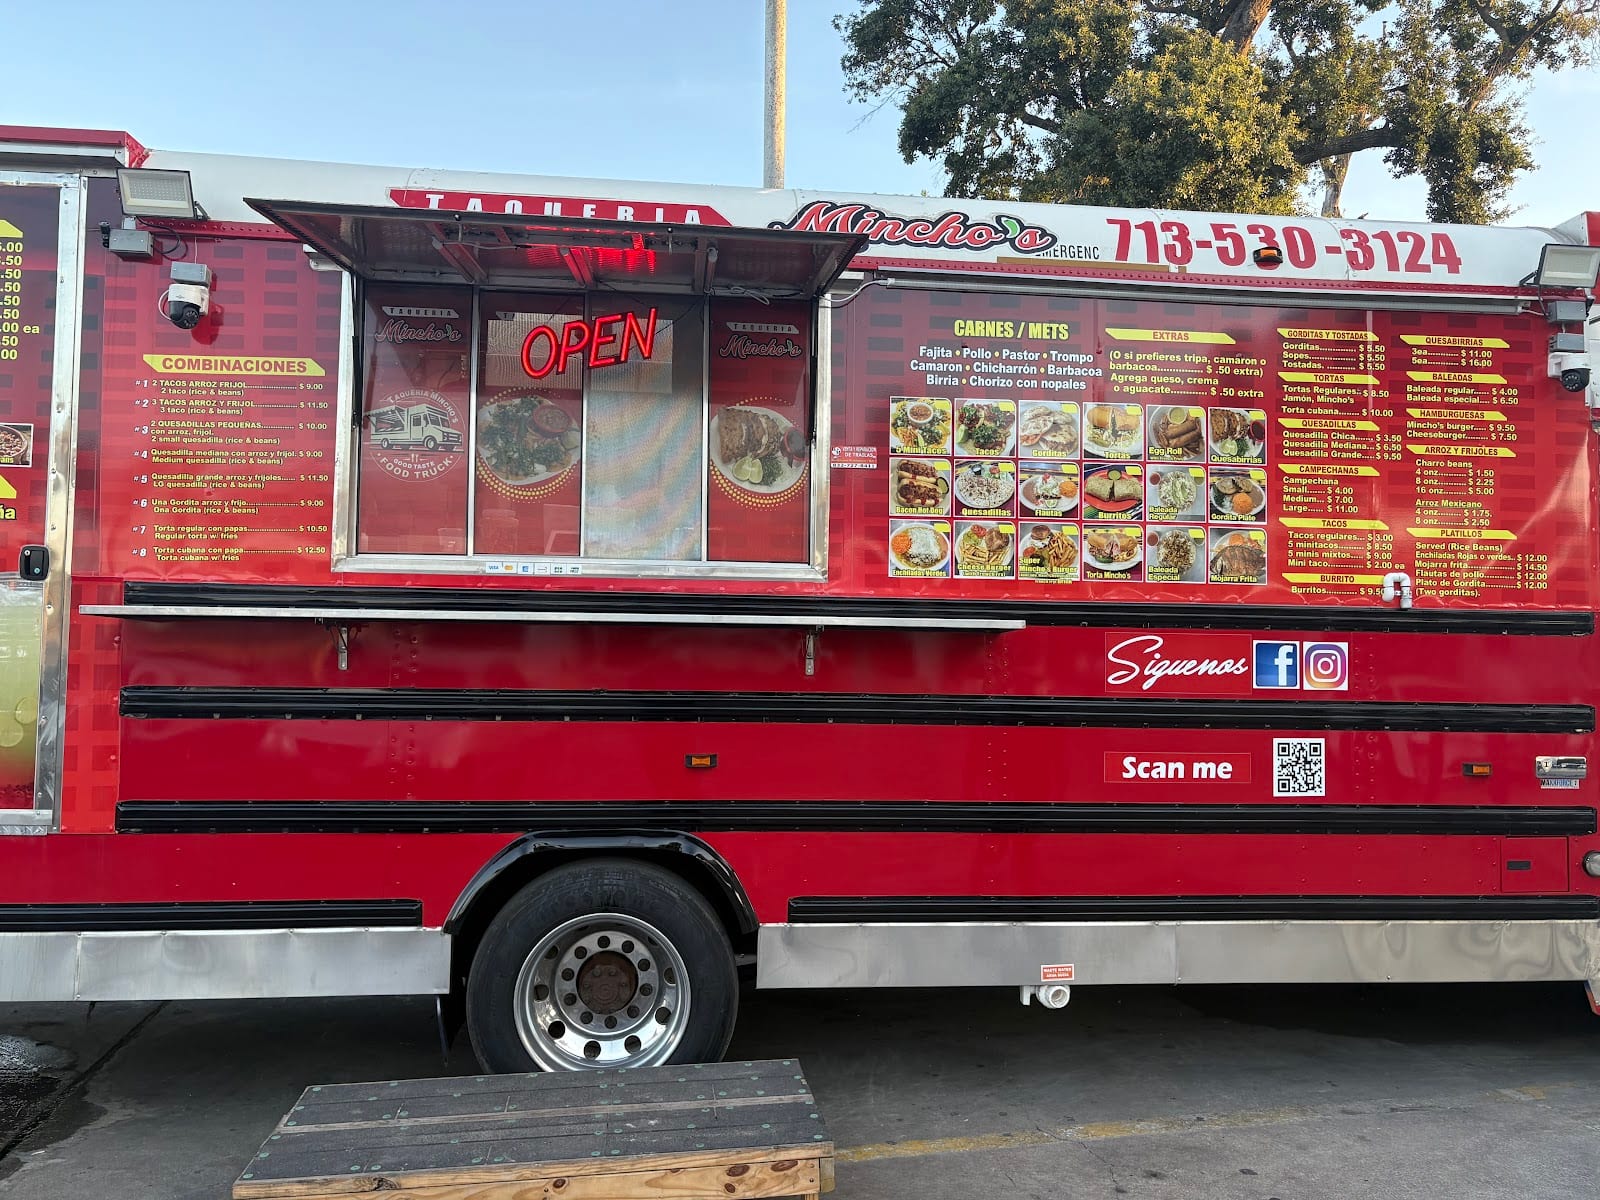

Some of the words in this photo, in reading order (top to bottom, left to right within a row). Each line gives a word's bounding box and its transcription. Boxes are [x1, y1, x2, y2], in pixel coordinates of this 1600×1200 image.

[771, 202, 1054, 251] Mincho's
[23, 325, 40, 334] ea
[375, 318, 462, 344] Mincho's
[953, 319, 1014, 339] CARNES
[1028, 322, 1070, 341] METS
[1152, 331, 1190, 341] EXTRAS
[1287, 330, 1324, 339] GORDITAS
[1333, 331, 1368, 340] TOSTADAS
[521, 307, 658, 380] OPEN
[1425, 336, 1484, 346] QUESABIRRIAS
[719, 334, 802, 359] Mincho's
[919, 346, 953, 360] Fajita
[963, 347, 992, 359] Pollo
[1002, 348, 1041, 361] Pastor
[1050, 350, 1094, 365] Trompo
[1124, 351, 1133, 360] si
[1135, 352, 1182, 365] prefieres
[1184, 353, 1211, 365] tripa,
[1213, 356, 1258, 366] camaron
[162, 357, 307, 373] COMBINACIONES
[910, 359, 963, 372] Camaron
[972, 361, 1038, 375] Chicharrón
[1047, 364, 1103, 377] Barbacoa
[1233, 367, 1264, 377] extra)
[1110, 372, 1148, 385] Agrega
[1150, 375, 1184, 386] queso,
[1187, 376, 1219, 386] crema
[1313, 374, 1345, 382] TORTAS
[1432, 373, 1473, 382] BALEADAS
[159, 379, 187, 387] TACOS
[188, 380, 218, 388] ARROZ
[926, 374, 959, 386] Birria
[969, 375, 1013, 388] Chorizo
[1016, 378, 1038, 388] con
[1041, 378, 1087, 392] nopales
[1237, 388, 1264, 398] extra
[1282, 384, 1311, 393] Tortas
[1406, 384, 1442, 393] Baleada
[387, 389, 430, 404] TAQUERIA
[1316, 395, 1355, 404] Mincho's
[1406, 393, 1442, 402] Baleada
[188, 399, 217, 407] ARROZ
[1281, 405, 1305, 414] Torta
[1419, 409, 1485, 419] HAMBURGUESAS
[158, 420, 216, 428] QUESADILLAS
[1301, 419, 1357, 428] QUESADILLAS
[1406, 420, 1445, 430] Mincho's
[1282, 430, 1329, 439] Quesadilla
[182, 436, 223, 445] quesadilla
[1282, 439, 1329, 448] Quesadilla
[151, 448, 194, 457] Quesadilla
[195, 449, 229, 457] mediana
[902, 446, 921, 454] Mini
[921, 447, 947, 455] Tacos
[975, 447, 1001, 456] Tacos
[1032, 449, 1067, 458] Gorditas
[1148, 447, 1166, 456] Egg
[1166, 447, 1183, 455] Roll
[1282, 448, 1329, 457] Quesadilla
[1424, 446, 1452, 454] ARROZ
[1461, 447, 1498, 456] FRIJOLES
[1104, 451, 1131, 460] Tortas
[1210, 455, 1263, 464] Quesabirrias
[152, 456, 184, 464] Medium
[185, 456, 227, 465] quesadilla
[393, 458, 413, 470] GOOD
[413, 461, 436, 470] TASTE
[1415, 459, 1445, 468] Charro
[1447, 459, 1473, 469] beans
[380, 456, 410, 478] FOOD
[414, 457, 453, 479] TRUCK
[1299, 465, 1359, 474] CAMPECHANAS
[151, 472, 194, 481] Quesadilla
[195, 473, 224, 482] grande
[1282, 476, 1339, 486] Campechana
[166, 480, 208, 489] quesadilla
[151, 498, 168, 506] Una
[169, 498, 200, 506] Gordita
[1415, 499, 1439, 507] Arroz
[1441, 499, 1482, 508] Mexicano
[961, 508, 1012, 517] Quesadillas
[1035, 509, 1063, 517] Flautas
[1149, 506, 1178, 514] Baleada
[1098, 511, 1132, 520] Burritos
[1149, 513, 1177, 522] Regular
[1211, 513, 1237, 521] Gordita
[1321, 519, 1348, 527] TACOS
[153, 524, 176, 532] Torta
[177, 525, 207, 534] regular
[1440, 529, 1483, 538] PLATILLOS
[154, 532, 186, 541] Regular
[188, 532, 208, 540] torta
[220, 532, 239, 540] fries
[1287, 531, 1314, 539] Tacos
[153, 546, 175, 554] Torta
[176, 546, 206, 554] cubana
[1415, 542, 1446, 550] Served
[1295, 550, 1319, 558] minis
[1415, 551, 1456, 559] Enchiladas
[1457, 552, 1478, 561] Rojas
[1019, 557, 1041, 566] Super
[1287, 558, 1306, 567] Mini
[1415, 560, 1448, 570] Mojarra
[892, 569, 925, 577] Enchiladas
[925, 569, 946, 577] Verdes
[1052, 566, 1078, 575] Burger
[1148, 565, 1179, 573] Baleada
[1415, 569, 1448, 578] Flautas
[1086, 570, 1103, 578] Torta
[1148, 573, 1180, 582] Especial
[1210, 574, 1239, 583] Mojarra
[1240, 575, 1258, 583] Frita
[1320, 574, 1355, 583] BURRITO
[1415, 578, 1438, 587] Plato
[1107, 635, 1249, 690] Siguenos
[1121, 756, 1185, 779] Scan
[1192, 761, 1233, 779] me
